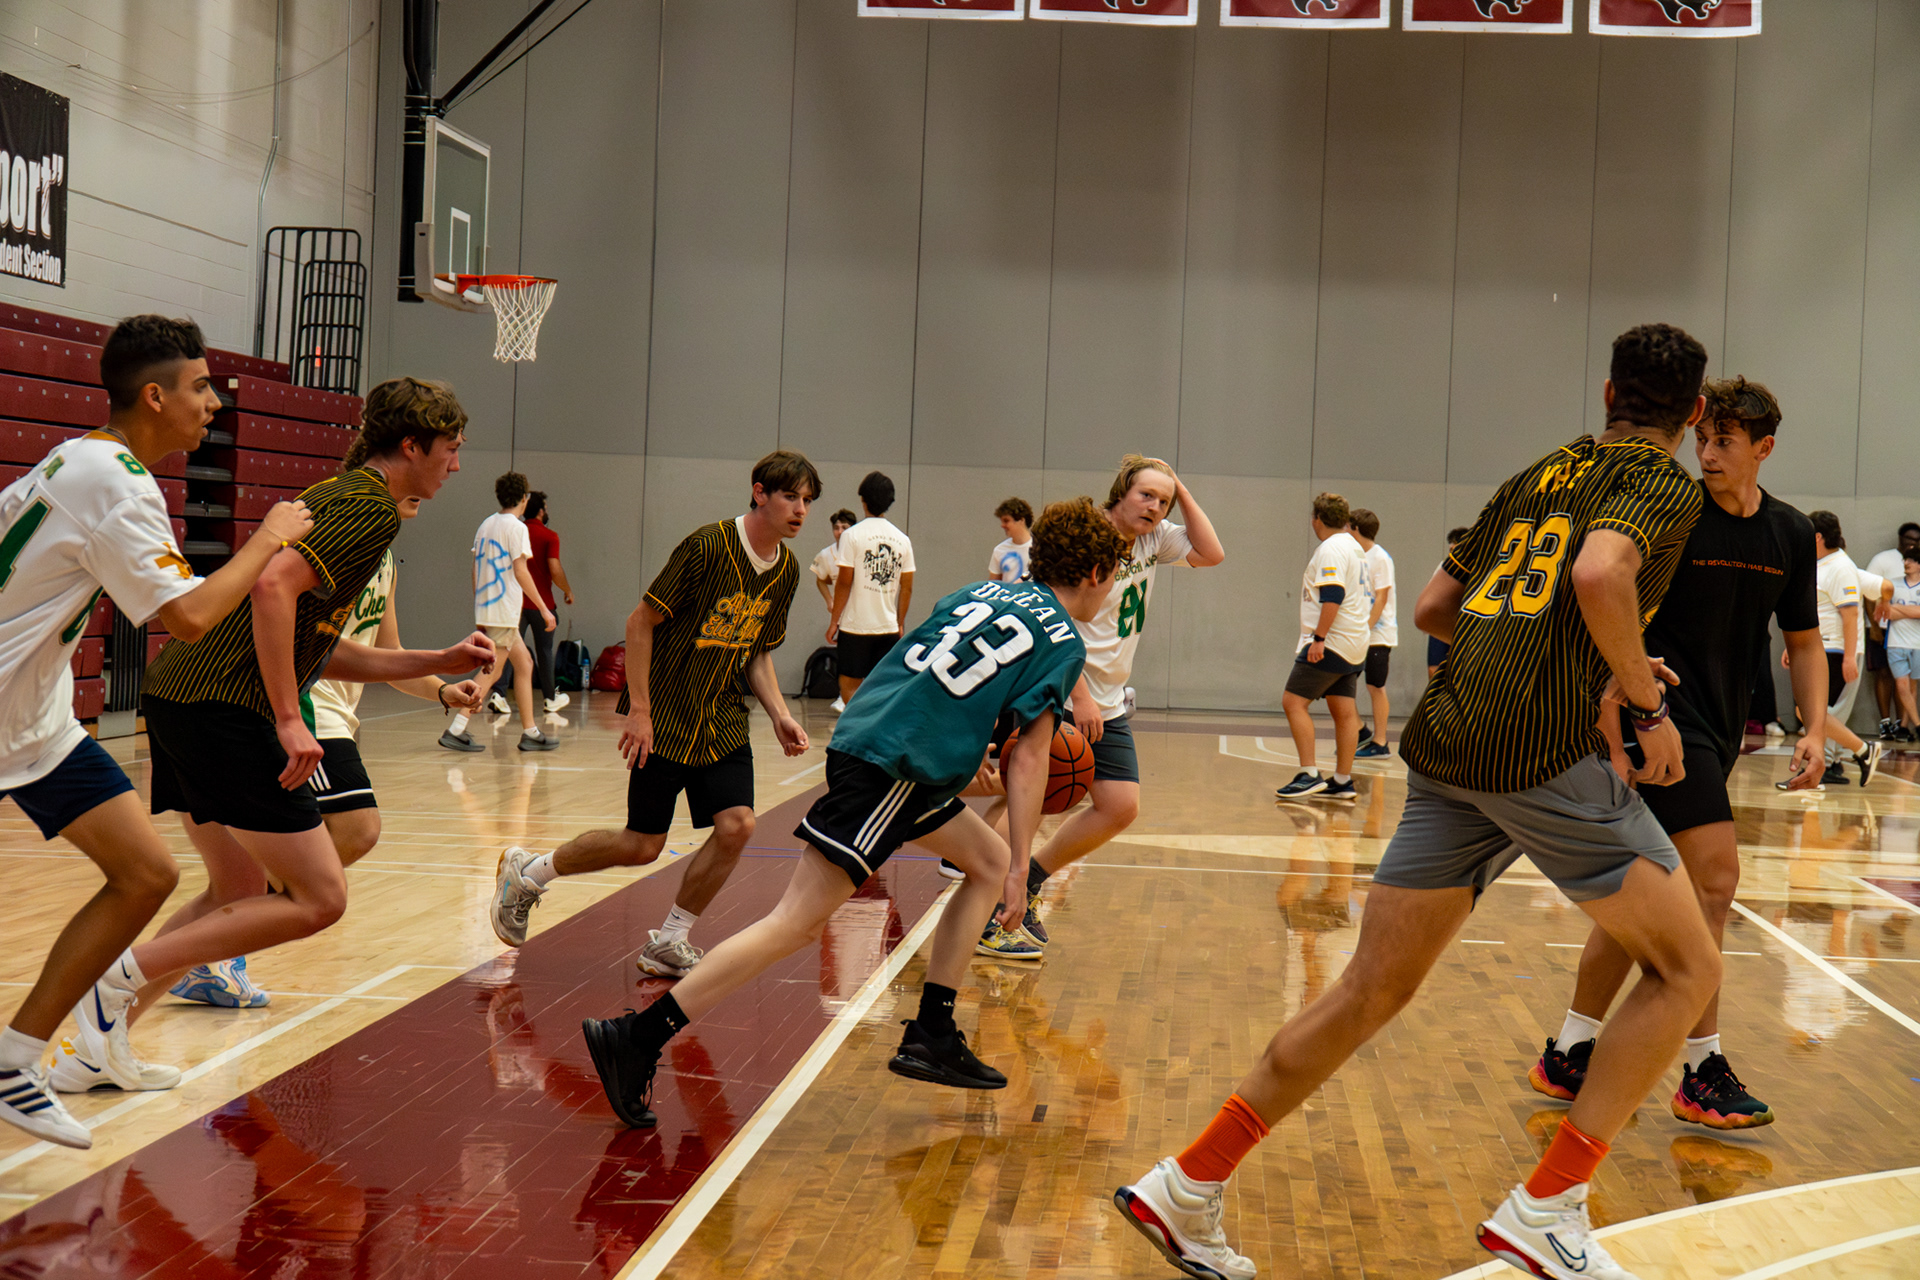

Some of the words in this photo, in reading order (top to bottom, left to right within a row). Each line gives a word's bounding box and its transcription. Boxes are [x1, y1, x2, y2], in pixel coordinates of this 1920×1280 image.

[23, 243, 62, 285] Section
[1461, 511, 1574, 619] 23
[903, 601, 1035, 697] 33
